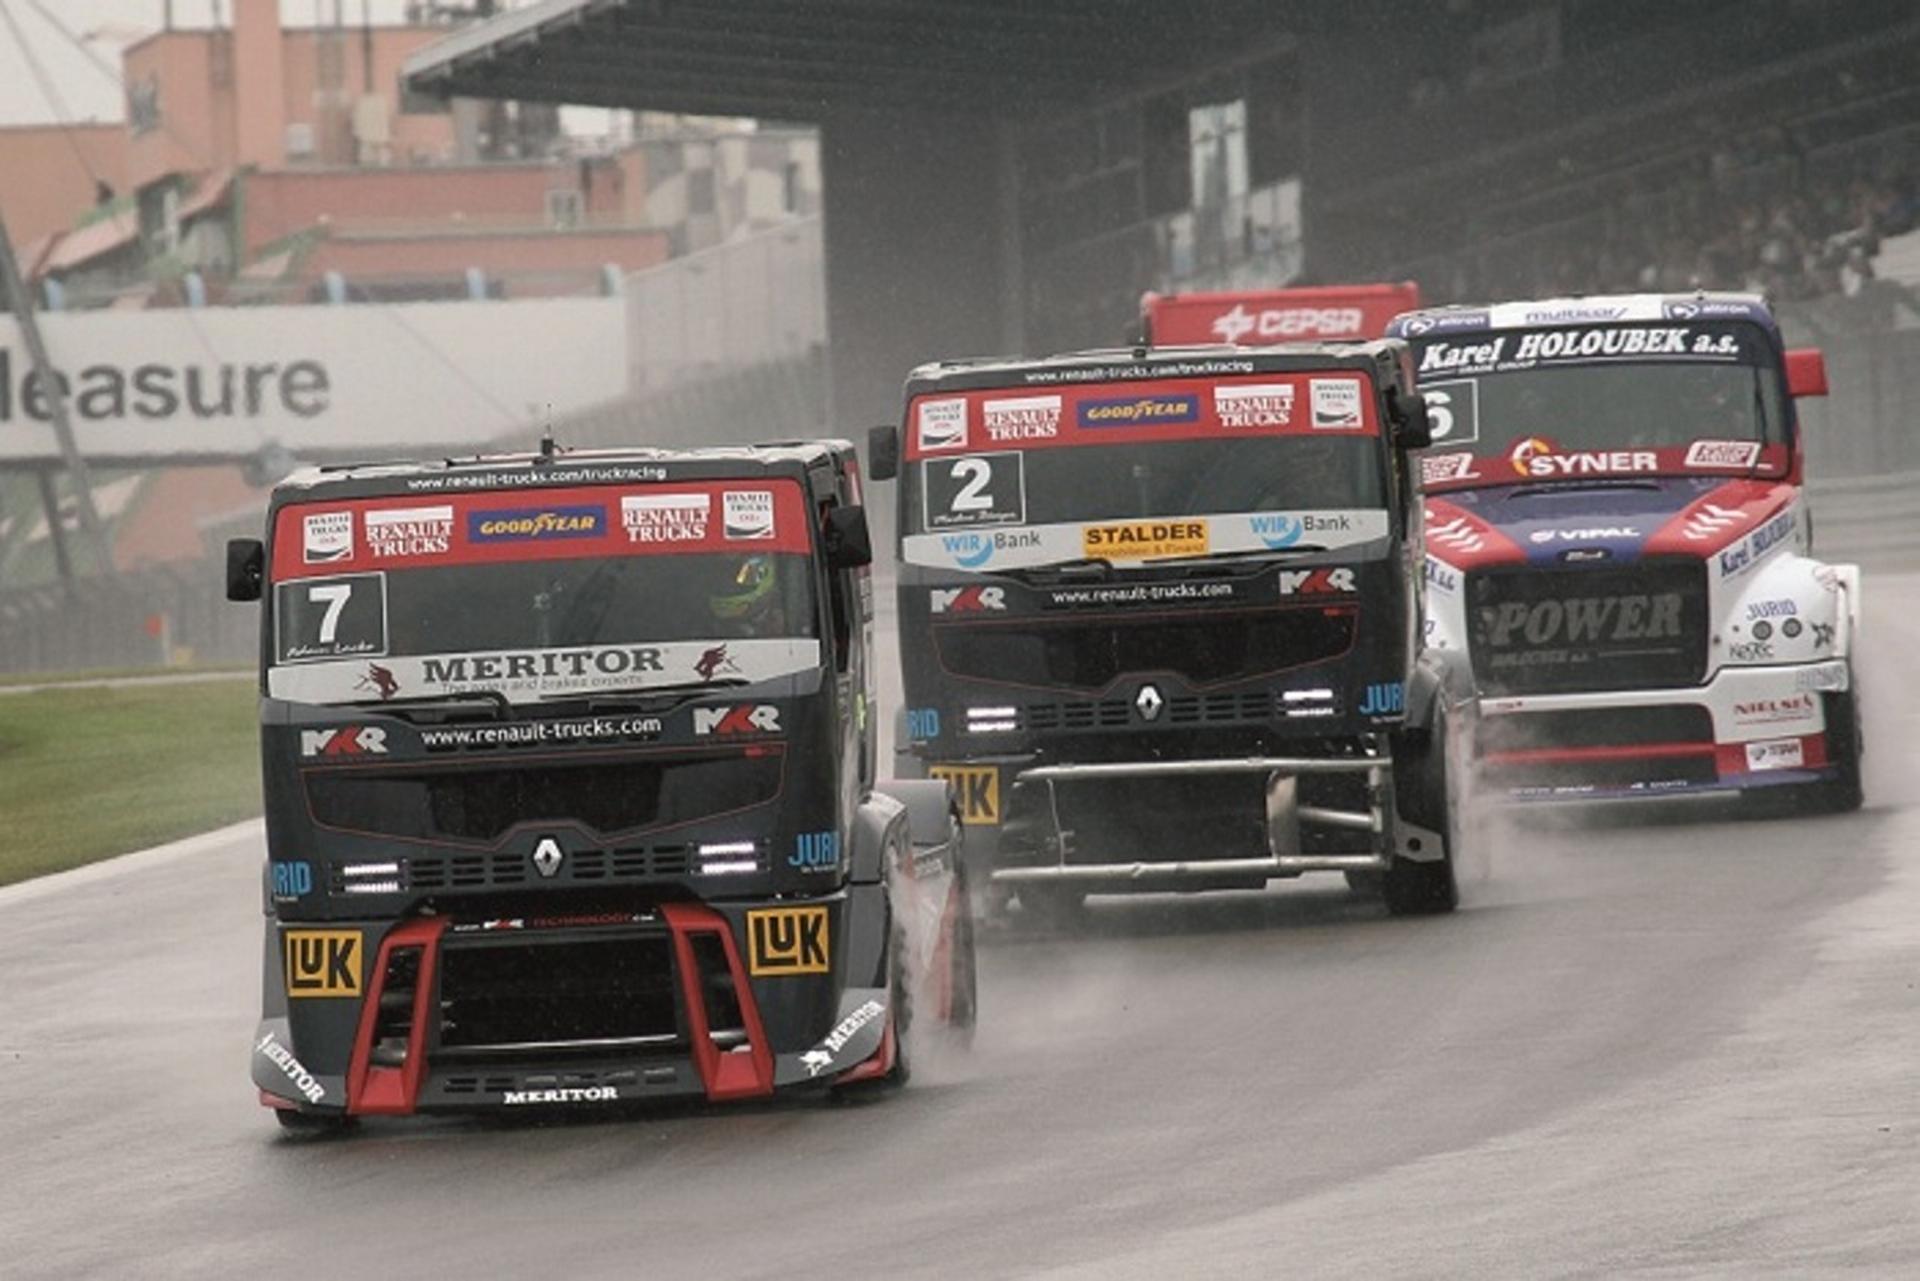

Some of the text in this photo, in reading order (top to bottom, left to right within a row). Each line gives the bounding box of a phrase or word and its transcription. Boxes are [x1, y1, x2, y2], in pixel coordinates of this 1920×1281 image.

[1258, 308, 1363, 335] CEPSA
[1418, 328, 1740, 372] Karel HOLOUBEK a.s.
[1025, 360, 1254, 381] www.renault-trucks.com/truckracing
[1087, 400, 1188, 420] GOODYEAR
[1215, 397, 1294, 414] RENAULT
[983, 408, 1062, 428] RENAULT
[1219, 410, 1290, 427] TRUCKS
[988, 423, 1057, 441] TRUCKS
[1529, 452, 1658, 475] SYNER
[407, 466, 667, 490] www.renault-trucks.com/truckracing
[950, 457, 994, 511] 2
[479, 512, 596, 537] GOODYEAR
[622, 506, 709, 528] RENAULT
[1249, 515, 1351, 534] WIR Bank
[366, 520, 454, 542] RENAULT
[627, 525, 705, 542] TRUCKS
[942, 530, 1042, 553] WIR Bank
[1086, 523, 1205, 545] STALDER
[1559, 528, 1641, 541] VIPAL
[370, 537, 450, 557] TRUCKS
[1279, 568, 1358, 594] MKR
[930, 584, 1007, 613] MKR
[1051, 582, 1233, 604] www.renault-trucks.com
[308, 584, 352, 644] 7
[1490, 593, 1683, 646] POWER
[1745, 598, 1798, 621] JURID
[422, 648, 665, 684] MERITOR
[693, 703, 782, 735] MKR
[301, 724, 389, 757] MKR
[420, 717, 663, 745] www.renault-trucks.com
[503, 1086, 619, 1106] MERITOR
